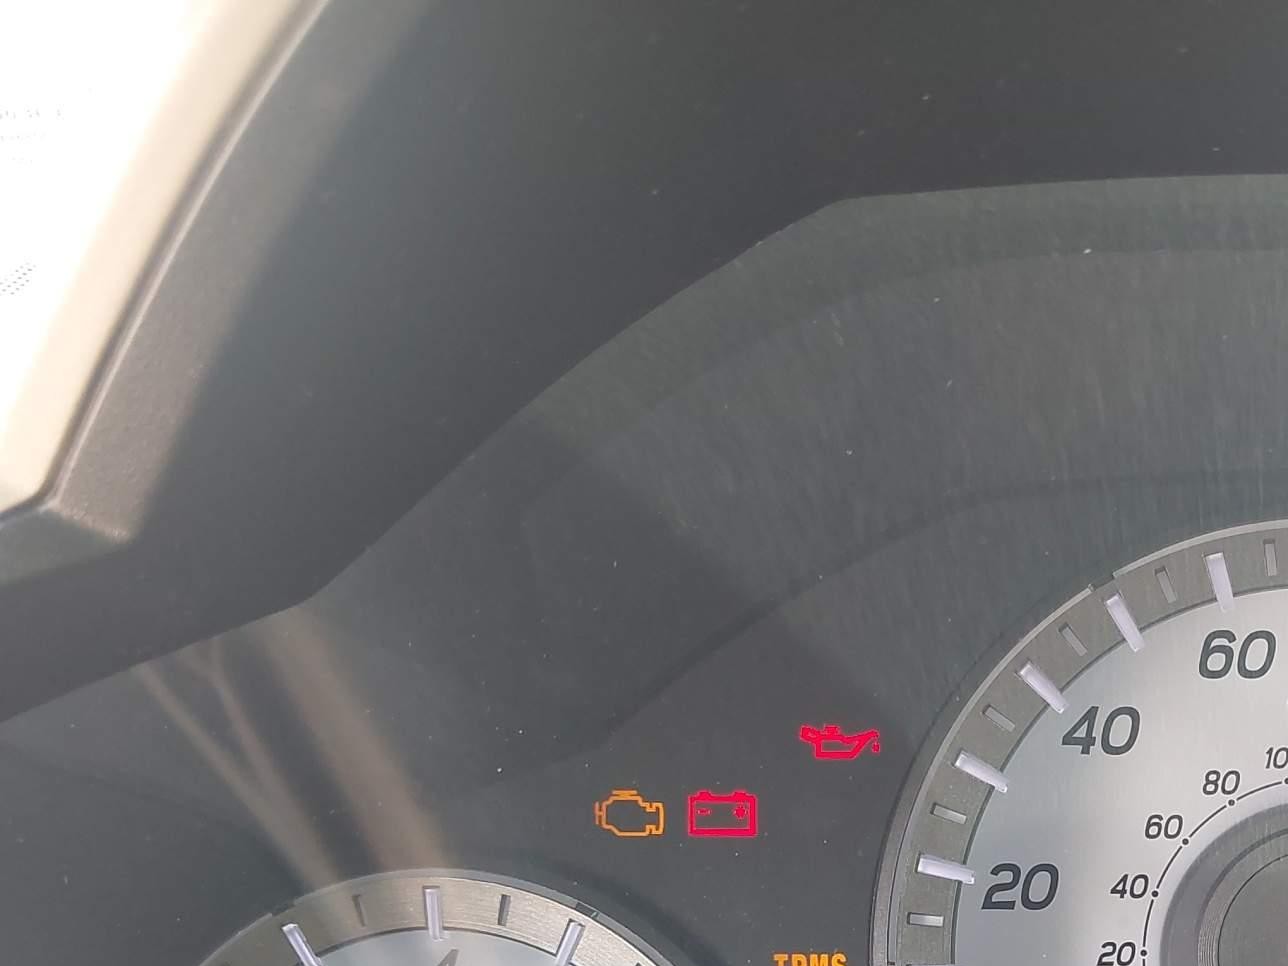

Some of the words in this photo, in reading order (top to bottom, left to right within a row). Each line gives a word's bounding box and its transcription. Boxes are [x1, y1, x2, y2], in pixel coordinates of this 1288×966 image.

[1199, 630, 1277, 680] 60
[1062, 706, 1141, 756] 40
[1202, 769, 1241, 796] 80
[1144, 814, 1184, 840] 60
[981, 863, 1059, 911] 20
[1109, 873, 1149, 899] 40
[1096, 941, 1136, 966] 20
